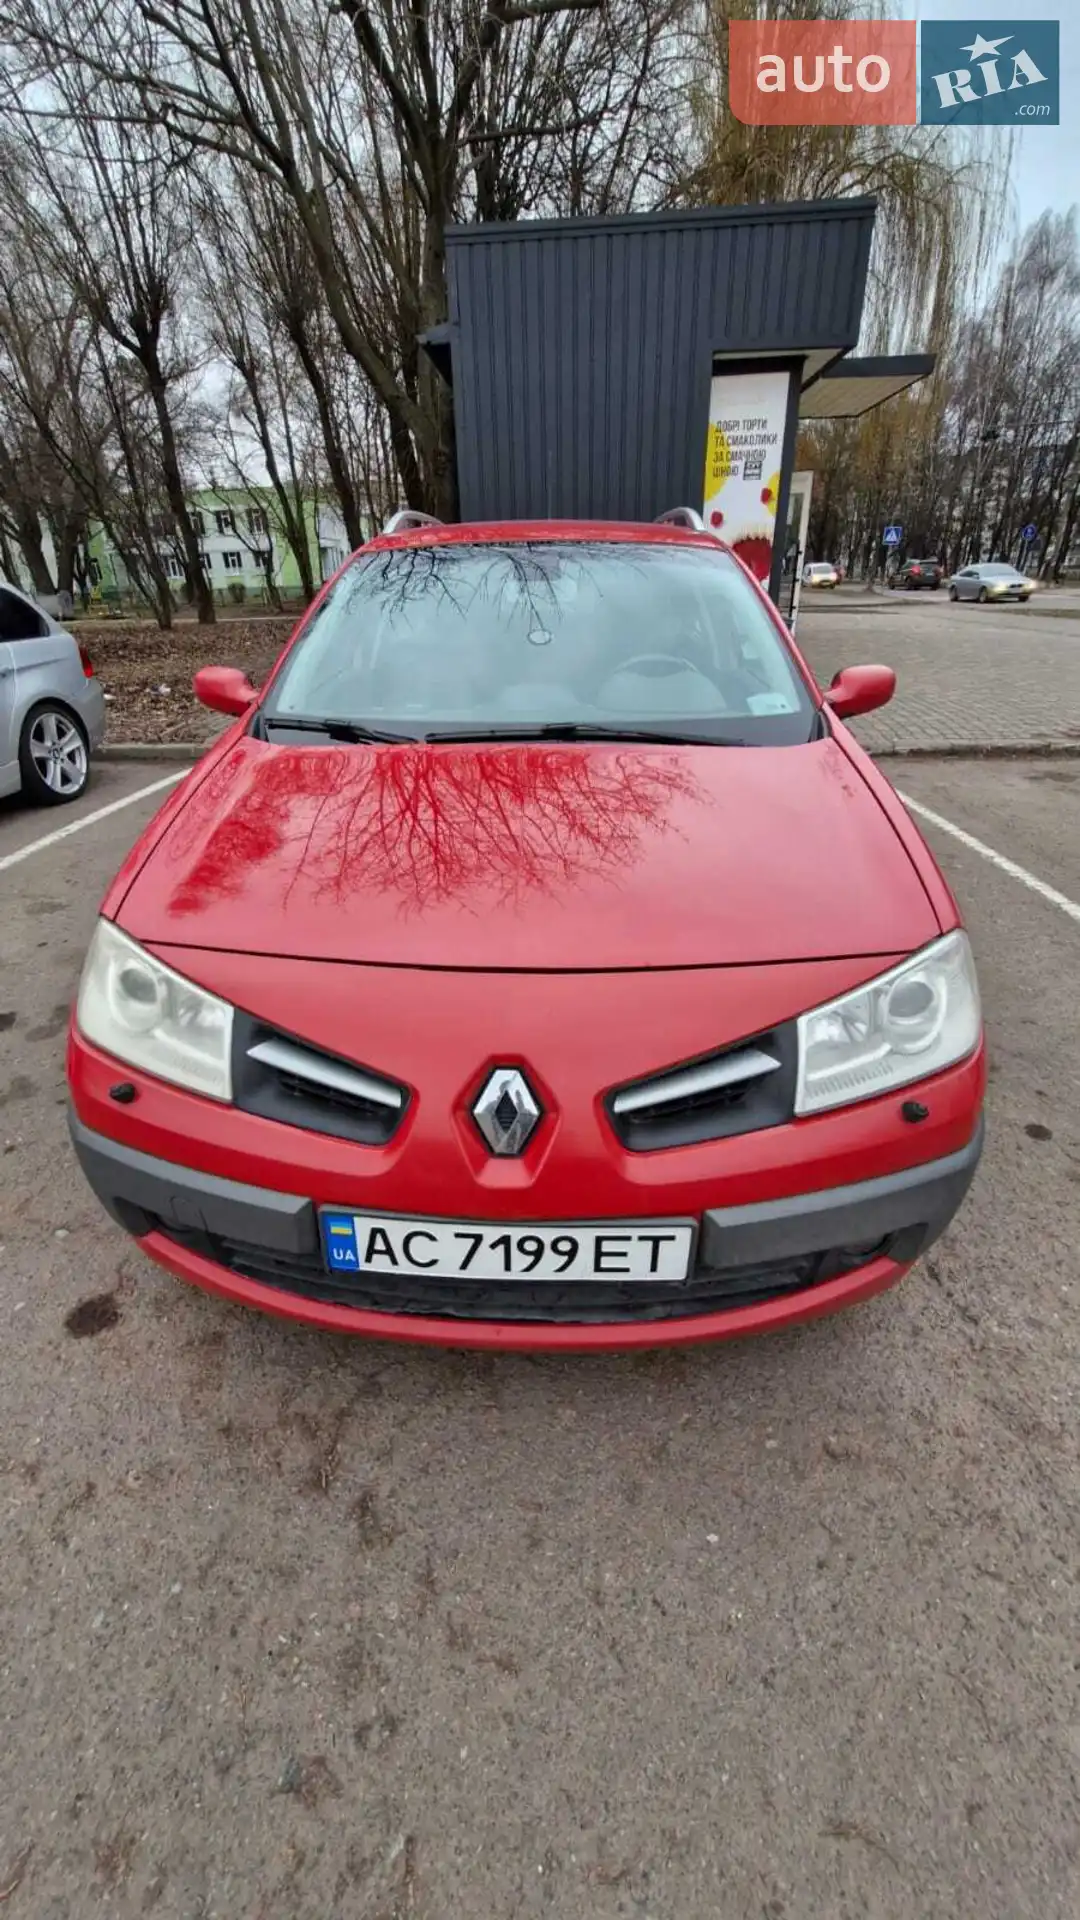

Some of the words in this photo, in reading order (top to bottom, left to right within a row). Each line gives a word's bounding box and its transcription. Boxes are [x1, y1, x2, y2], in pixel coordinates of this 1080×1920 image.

[742, 417, 767, 431] ТОРТИ
[714, 434, 725, 447] ТА
[726, 433, 777, 446] СМАКОЛИКИ
[333, 1247, 356, 1261] UA
[364, 1226, 439, 1268] AC
[453, 1232, 579, 1273] 7199
[593, 1235, 676, 1273] ET
